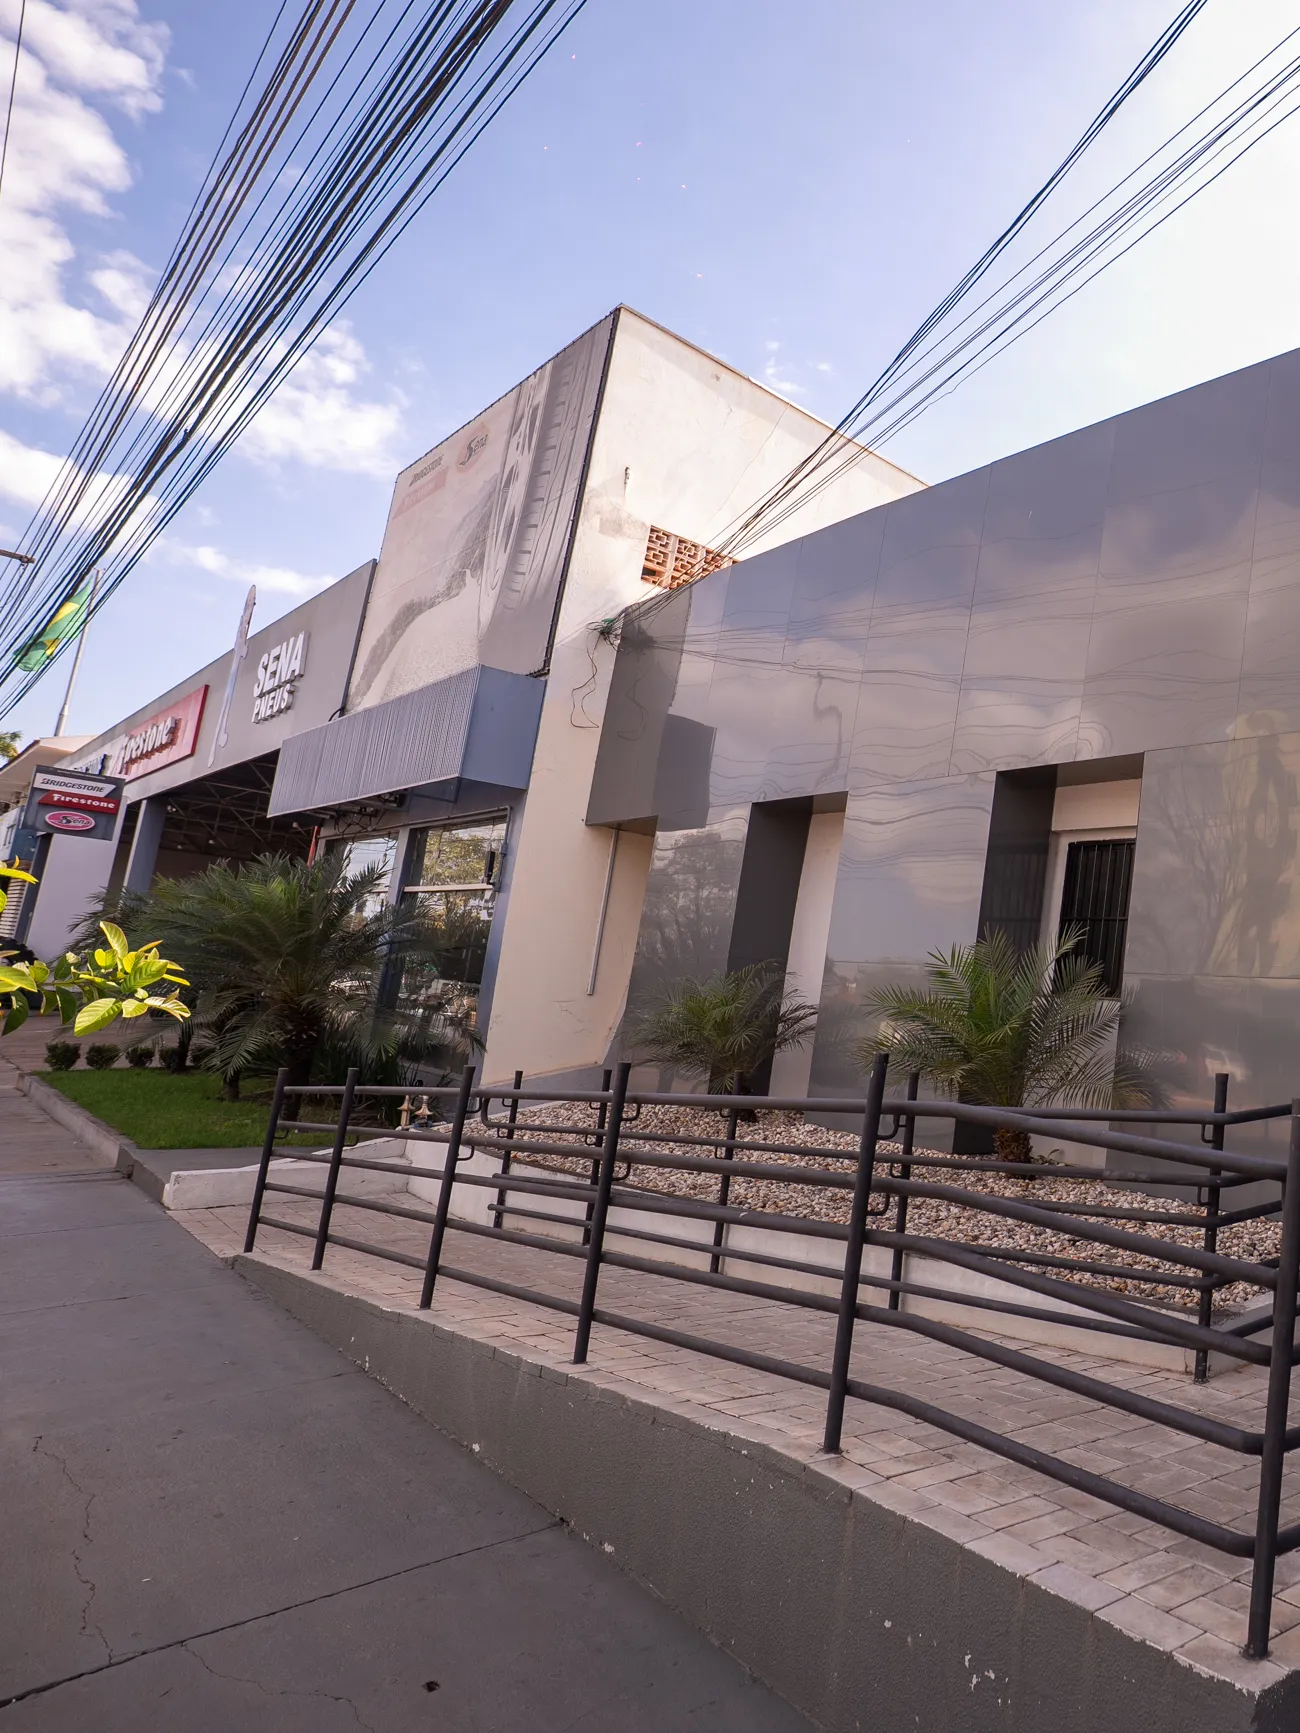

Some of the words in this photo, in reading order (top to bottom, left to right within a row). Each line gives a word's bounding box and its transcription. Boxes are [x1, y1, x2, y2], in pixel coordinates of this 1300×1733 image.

[253, 631, 306, 698] SENA
[252, 683, 295, 724] PNEUS
[41, 778, 105, 793] BRIDGESTONE
[52, 793, 116, 809] Firestone
[57, 815, 91, 825] Sena
